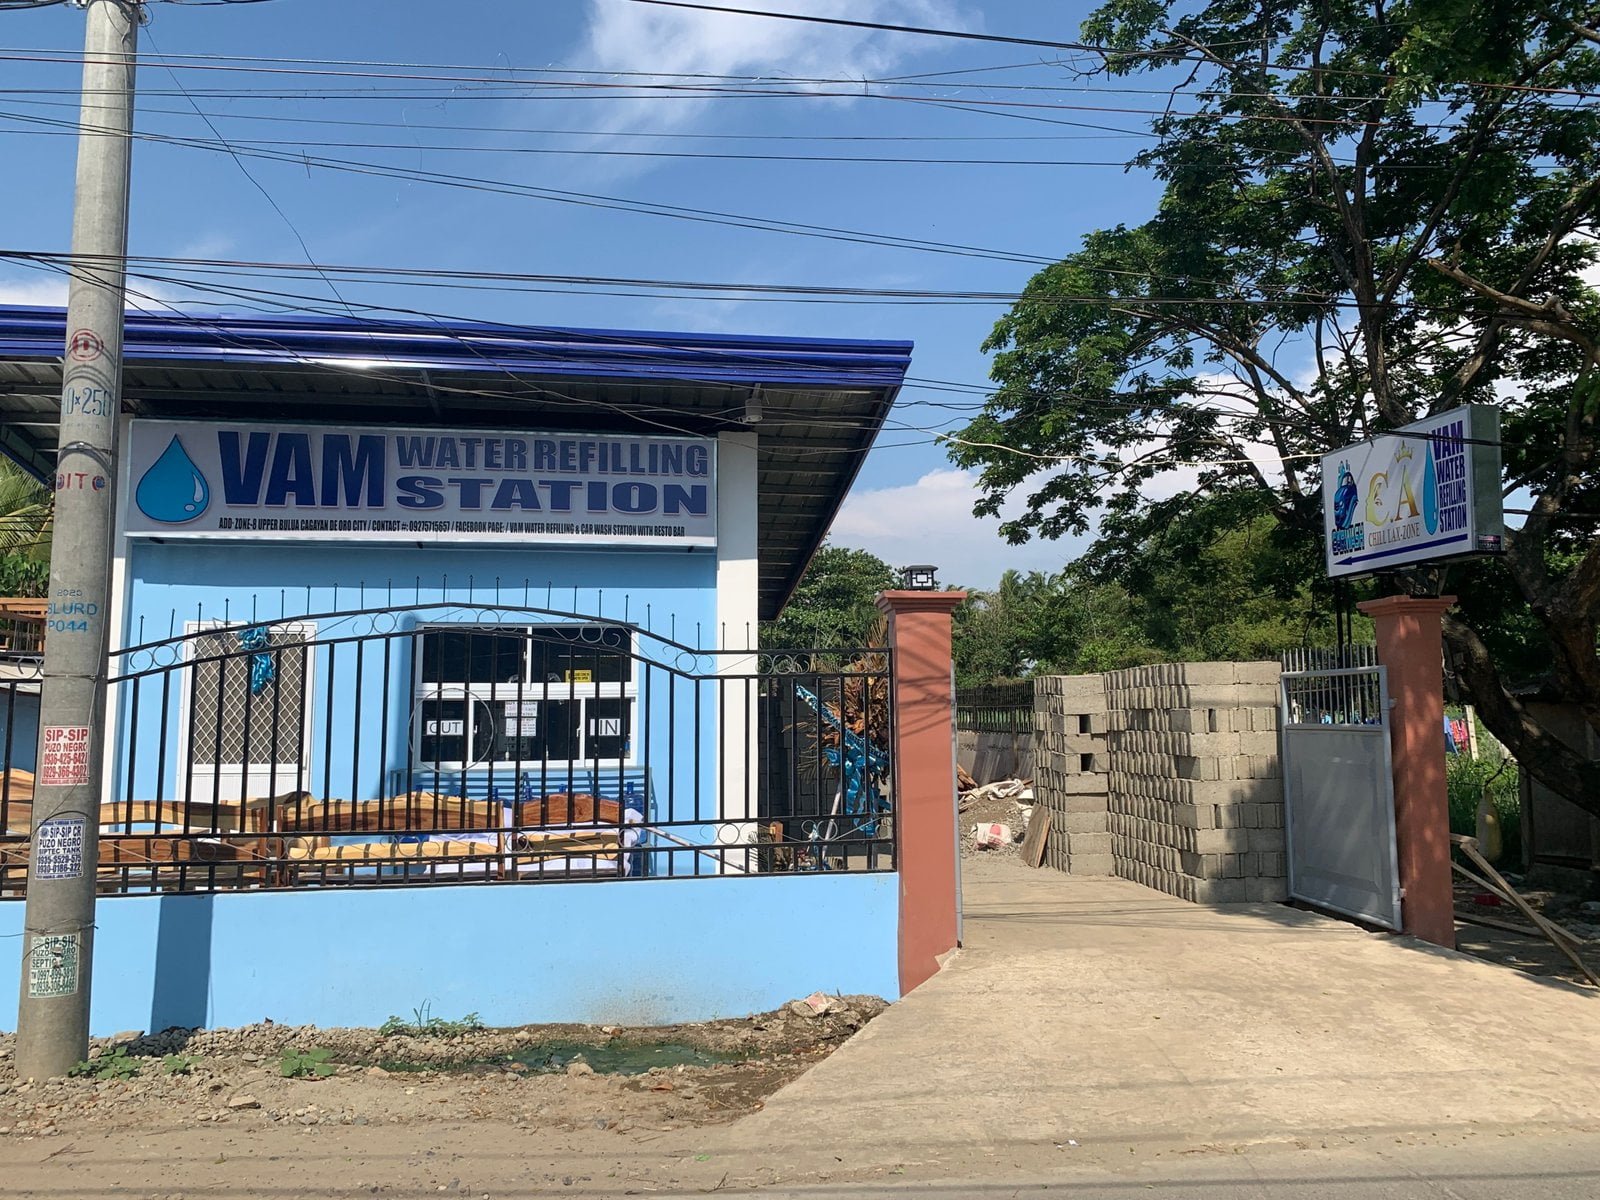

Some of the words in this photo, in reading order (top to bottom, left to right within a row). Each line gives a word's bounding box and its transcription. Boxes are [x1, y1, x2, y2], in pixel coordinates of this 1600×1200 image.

[1431, 420, 1465, 461] VAM
[396, 435, 528, 471] WATER
[533, 438, 709, 478] REFILLING
[1436, 454, 1466, 484] WATER
[217, 430, 387, 509] VAM
[395, 475, 709, 516] STATION
[1439, 479, 1467, 509] REFILLING
[258, 518, 278, 531] UPPER
[279, 519, 300, 531] BULUA
[300, 519, 328, 531] CAGAYAN
[329, 519, 338, 531] DE
[339, 519, 352, 532] ORO
[352, 520, 368, 532] CITY
[372, 520, 401, 532] CONTACT
[455, 520, 487, 533] FACEBOOK
[510, 521, 524, 534] VAM
[524, 521, 545, 534] WATER
[546, 522, 575, 535] REFILLING
[580, 523, 593, 535] CAR
[594, 524, 612, 536] WASH
[613, 524, 637, 536] STATION
[637, 524, 653, 537] WITH
[654, 525, 672, 537] RESTO
[673, 526, 685, 538] BAR
[1439, 503, 1468, 533] STATION
[46, 729, 88, 742] SIP-SIP
[429, 721, 461, 734] OUT
[600, 720, 617, 735] IN
[45, 743, 61, 752] PUZO
[39, 838, 56, 848] PUZO
[57, 837, 81, 847] NEGRO
[50, 826, 72, 838] SIP-SIP
[73, 826, 82, 837] CR
[44, 935, 76, 949] SIP-SIP
